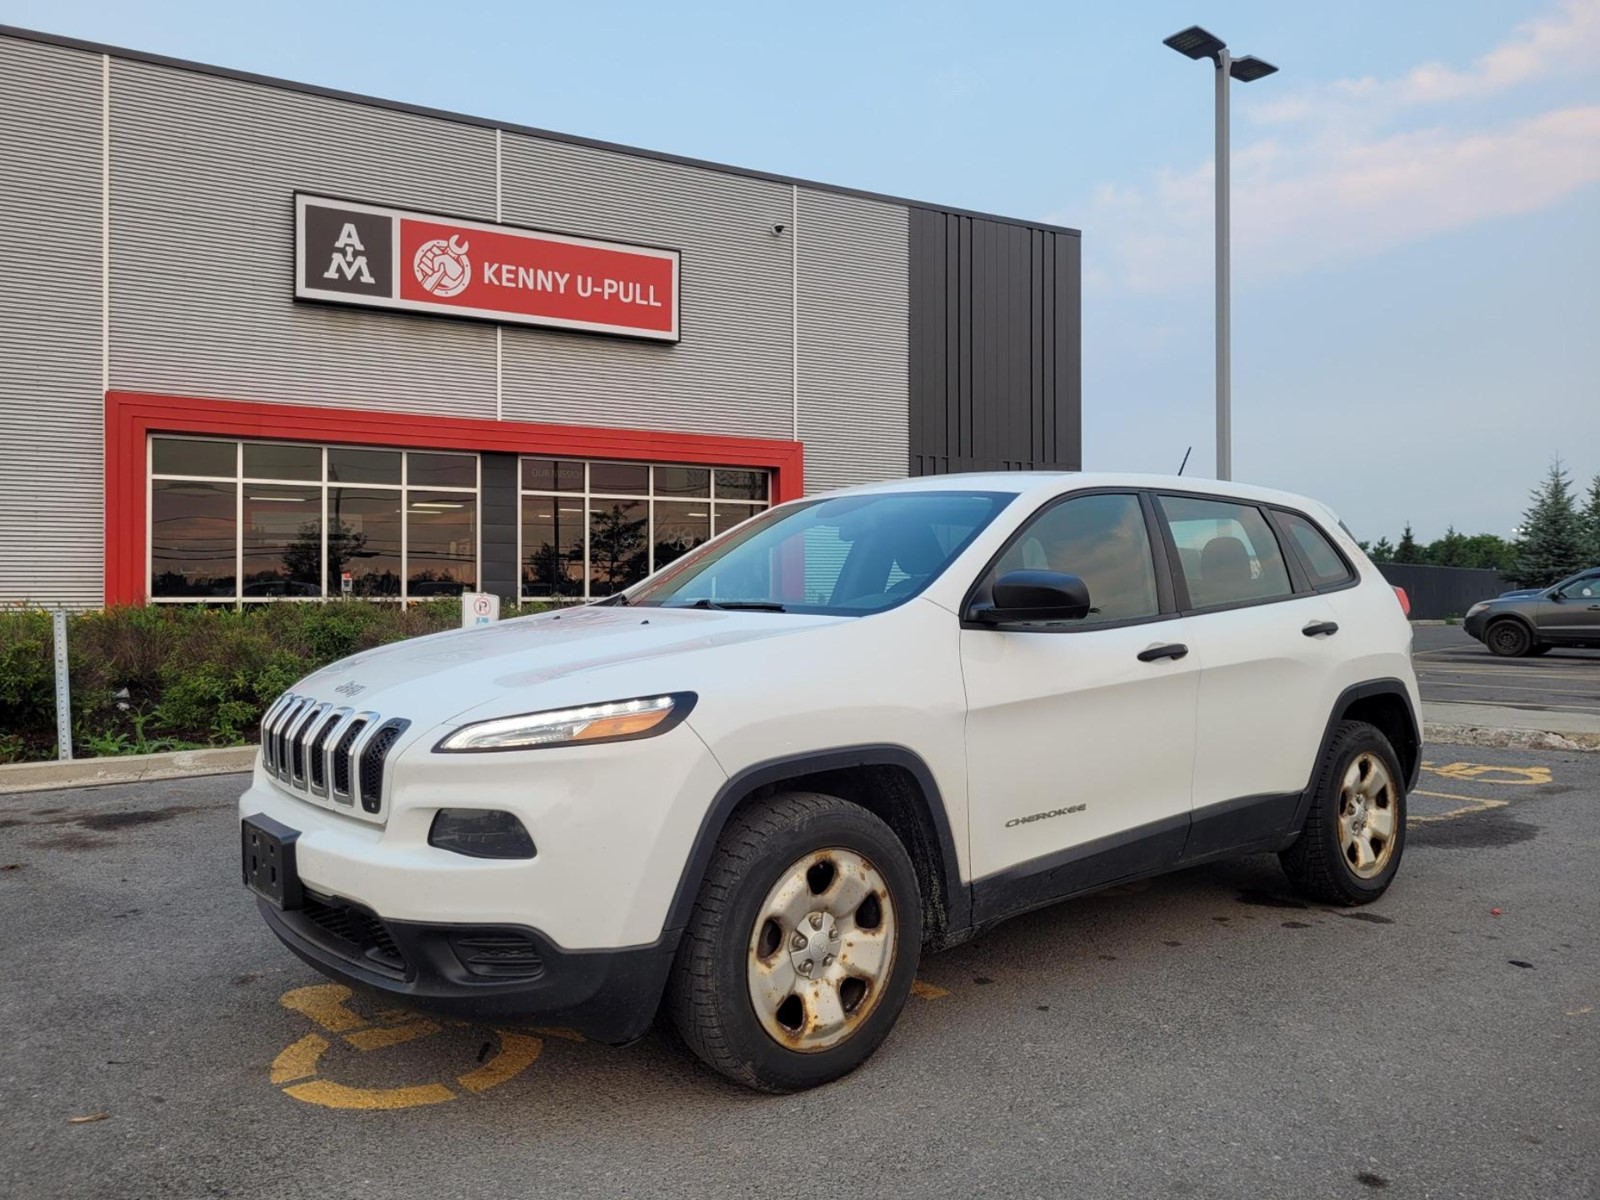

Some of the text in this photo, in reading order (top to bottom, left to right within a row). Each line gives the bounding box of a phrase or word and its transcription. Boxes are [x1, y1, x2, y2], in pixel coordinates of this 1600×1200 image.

[484, 262, 662, 307] KENNY U-PULL
[1005, 803, 1087, 828] CHEROKEE
